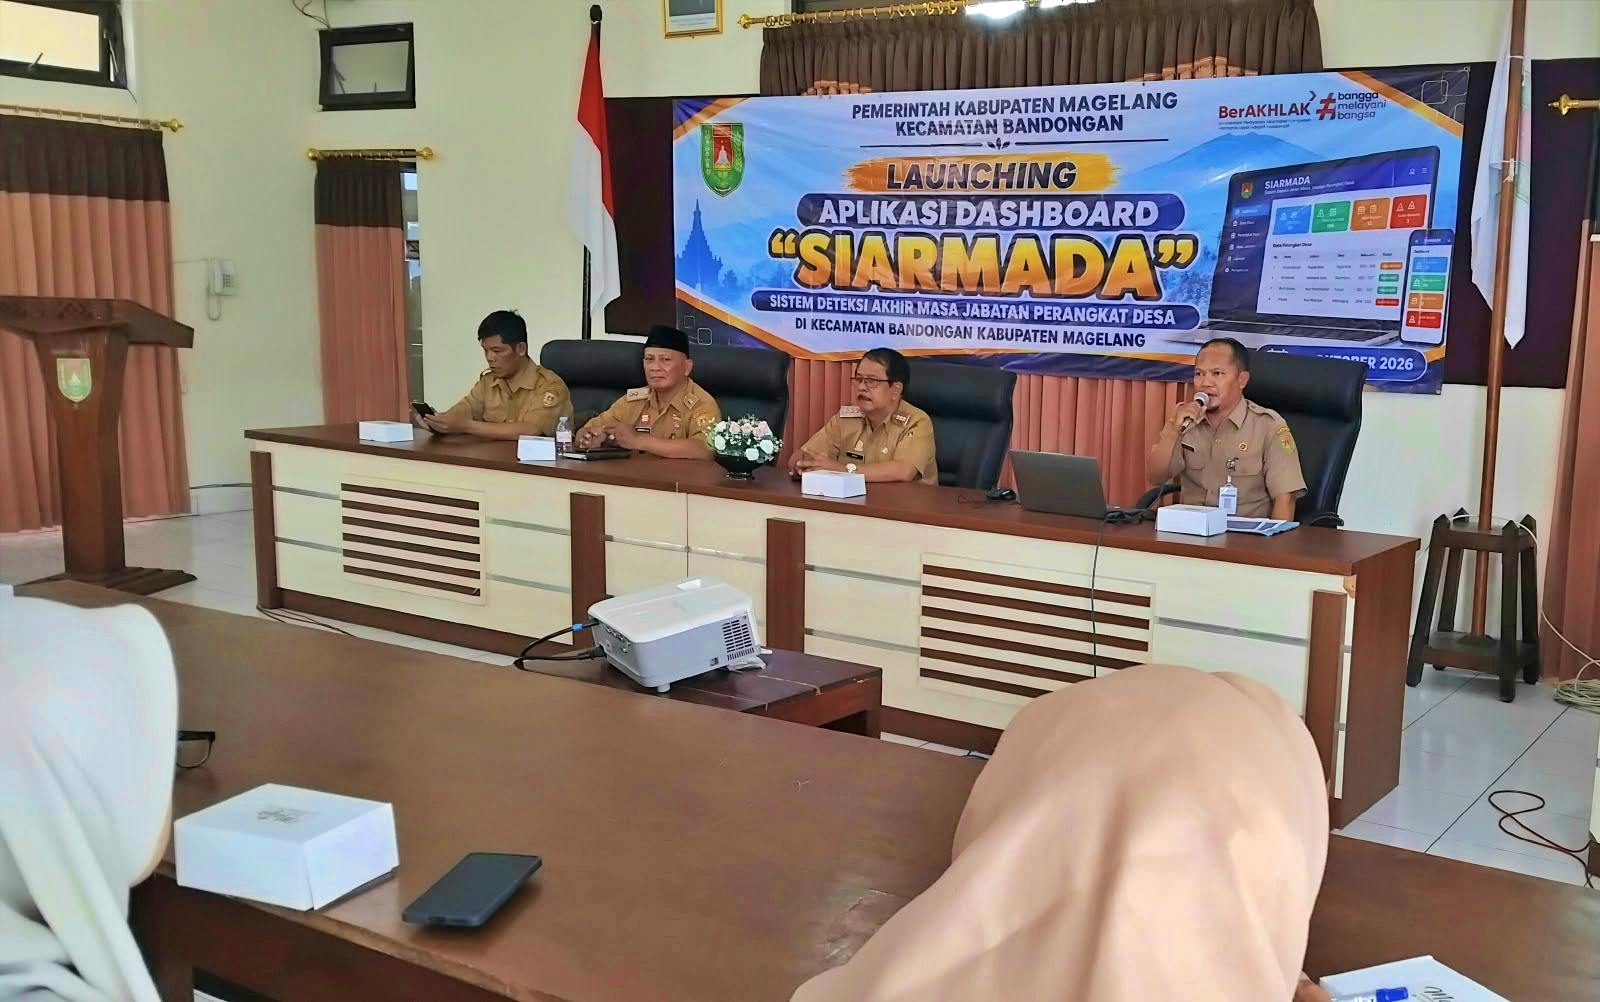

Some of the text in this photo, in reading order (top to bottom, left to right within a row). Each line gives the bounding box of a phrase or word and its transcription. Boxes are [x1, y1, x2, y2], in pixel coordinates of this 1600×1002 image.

[852, 92, 1178, 119] PEMERINTAH KABUPATEN MAGELANG
[1337, 92, 1379, 104] bangga
[1337, 100, 1387, 111] melayani
[1218, 102, 1311, 119] BerAKHLAK
[1337, 110, 1376, 121] bangsa
[895, 114, 1124, 136] KECAMATAN BANDONGAN
[887, 161, 1077, 190] LAUNCHING
[1264, 175, 1311, 190] SIARMADA
[818, 199, 1159, 227] APLIKASI DASHBOARD
[769, 294, 1176, 325] SISTEM DETEKSI AKHIR MASA JABATAN PERANGKAT DESA
[795, 317, 1146, 348] DI KECAMATAN BANDONGAN KABUPATEN MAGELANG
[1379, 356, 1414, 371] 2026
